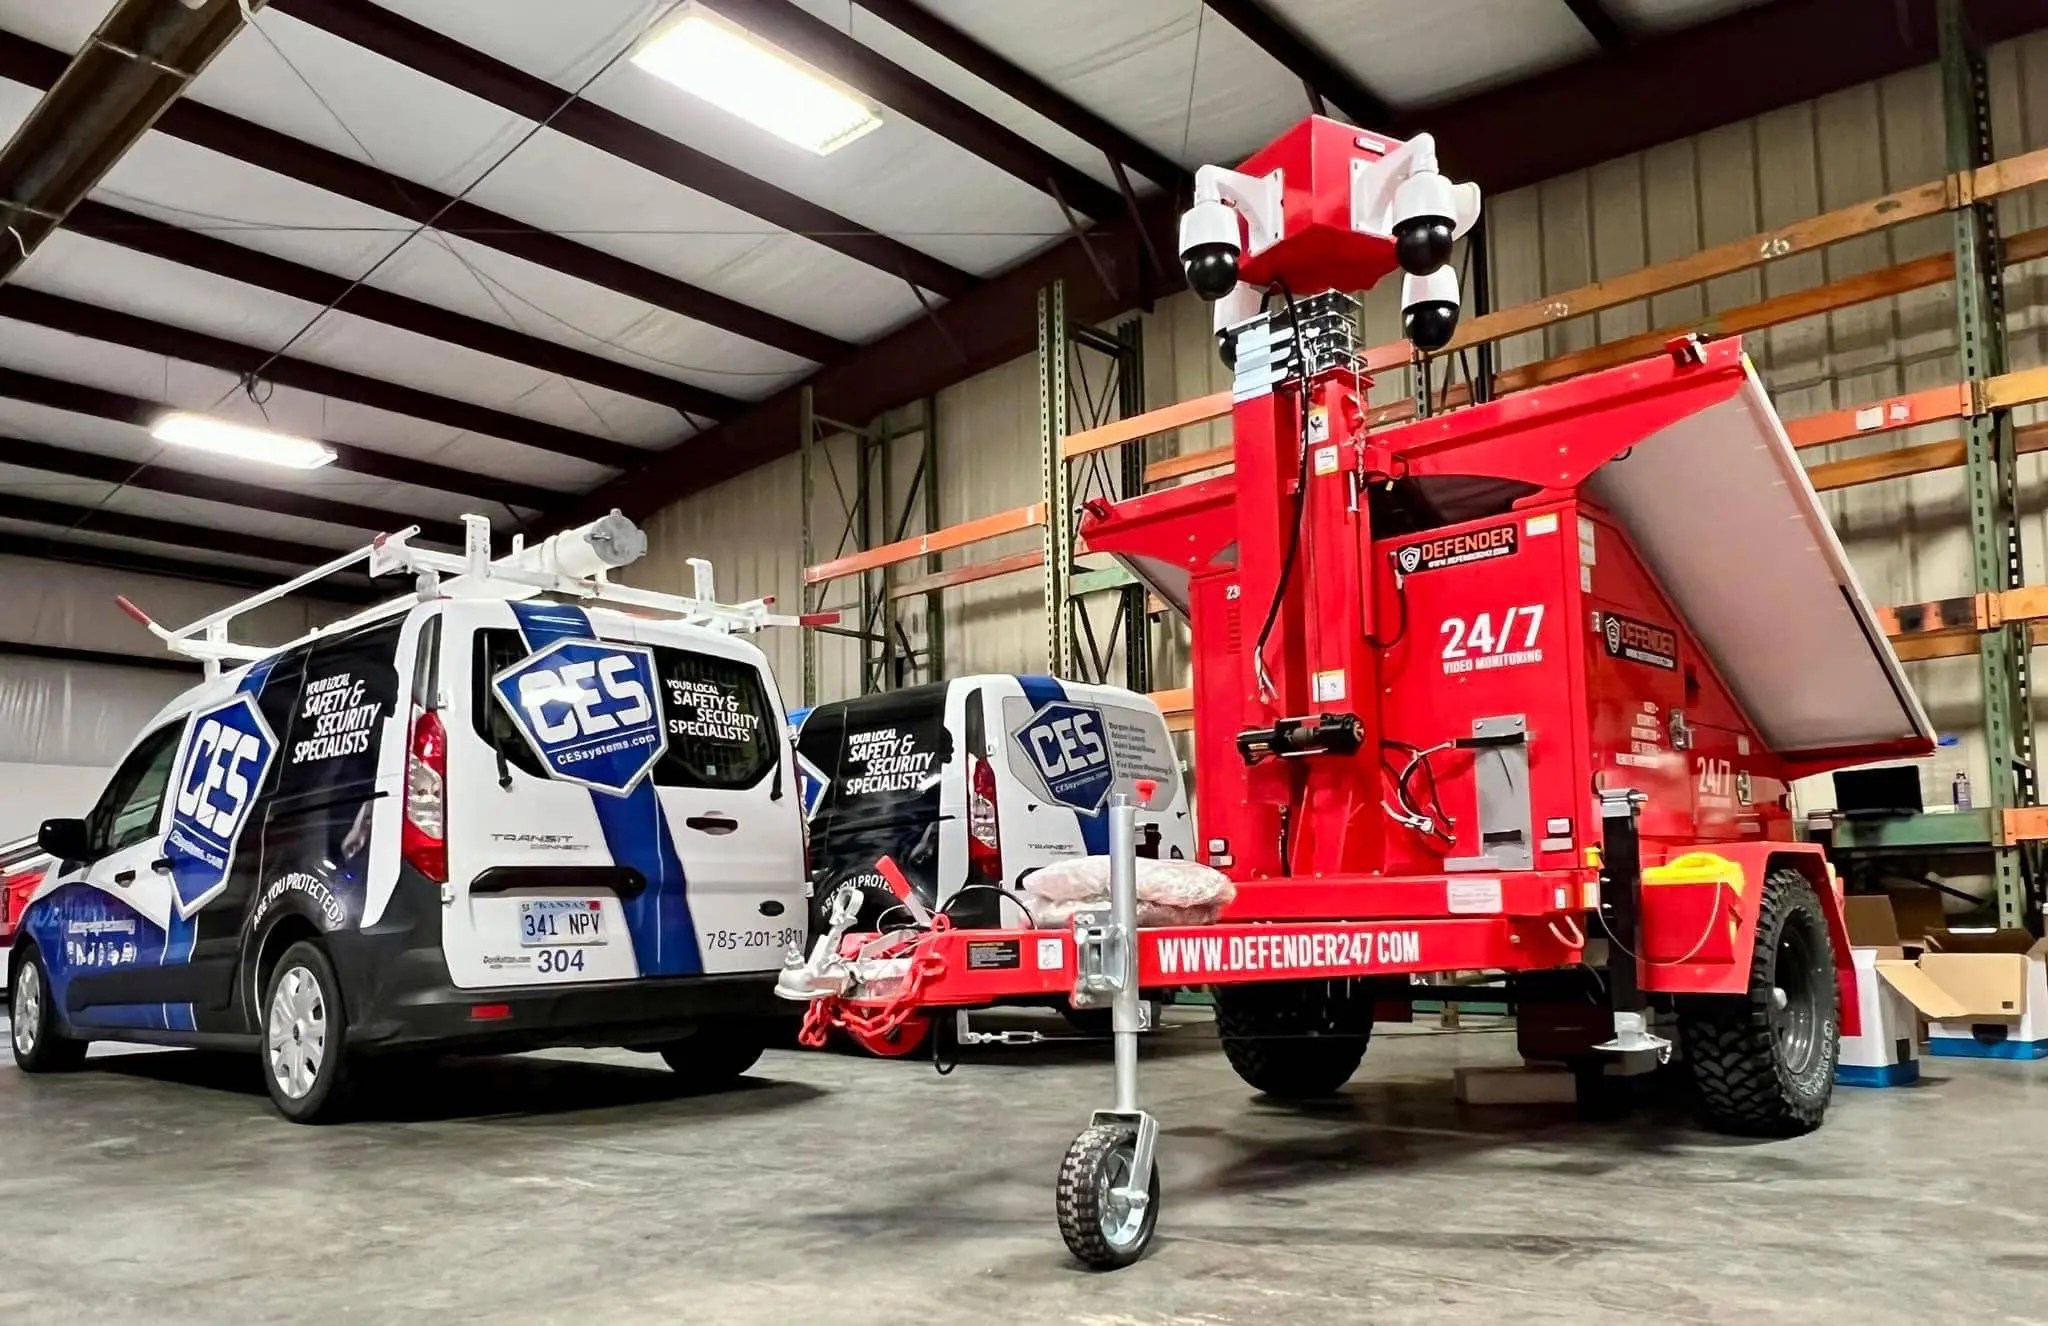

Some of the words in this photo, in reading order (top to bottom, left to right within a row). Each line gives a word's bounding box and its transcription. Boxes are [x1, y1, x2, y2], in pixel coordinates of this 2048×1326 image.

[1422, 527, 1515, 561] DEFENDER
[1440, 604, 1545, 660] 24/7
[1620, 619, 1676, 656] DEFENDER
[1442, 658, 1473, 675] VIDEO
[1475, 649, 1543, 671] MONITORING
[301, 686, 353, 719] SAFETY
[349, 679, 366, 708] &
[518, 654, 652, 744] CES
[666, 679, 693, 692] YOUR
[692, 682, 720, 696] LOCAL
[673, 690, 725, 710] SAFETY
[726, 695, 740, 712] &
[313, 702, 382, 738] SECURITY
[668, 719, 751, 742] SPECIALISTS
[696, 707, 760, 730] SECURITY
[292, 729, 370, 765] SPECIALISTS
[556, 733, 656, 766] CESsystems.com
[848, 732, 872, 746] YOUR
[871, 728, 897, 742] LOCAL
[848, 738, 901, 763] SAFETY
[900, 733, 916, 755] &
[1029, 712, 1106, 778] CES
[864, 751, 936, 777] SECURITY
[177, 719, 261, 838] CES
[845, 770, 928, 796] SPECIALISTS
[490, 833, 574, 843] TRANSIT
[538, 901, 586, 909] KANSAS
[524, 914, 558, 936] 341
[568, 913, 600, 935] NPV
[706, 927, 803, 951] 785-201-3811
[537, 949, 585, 973] 304
